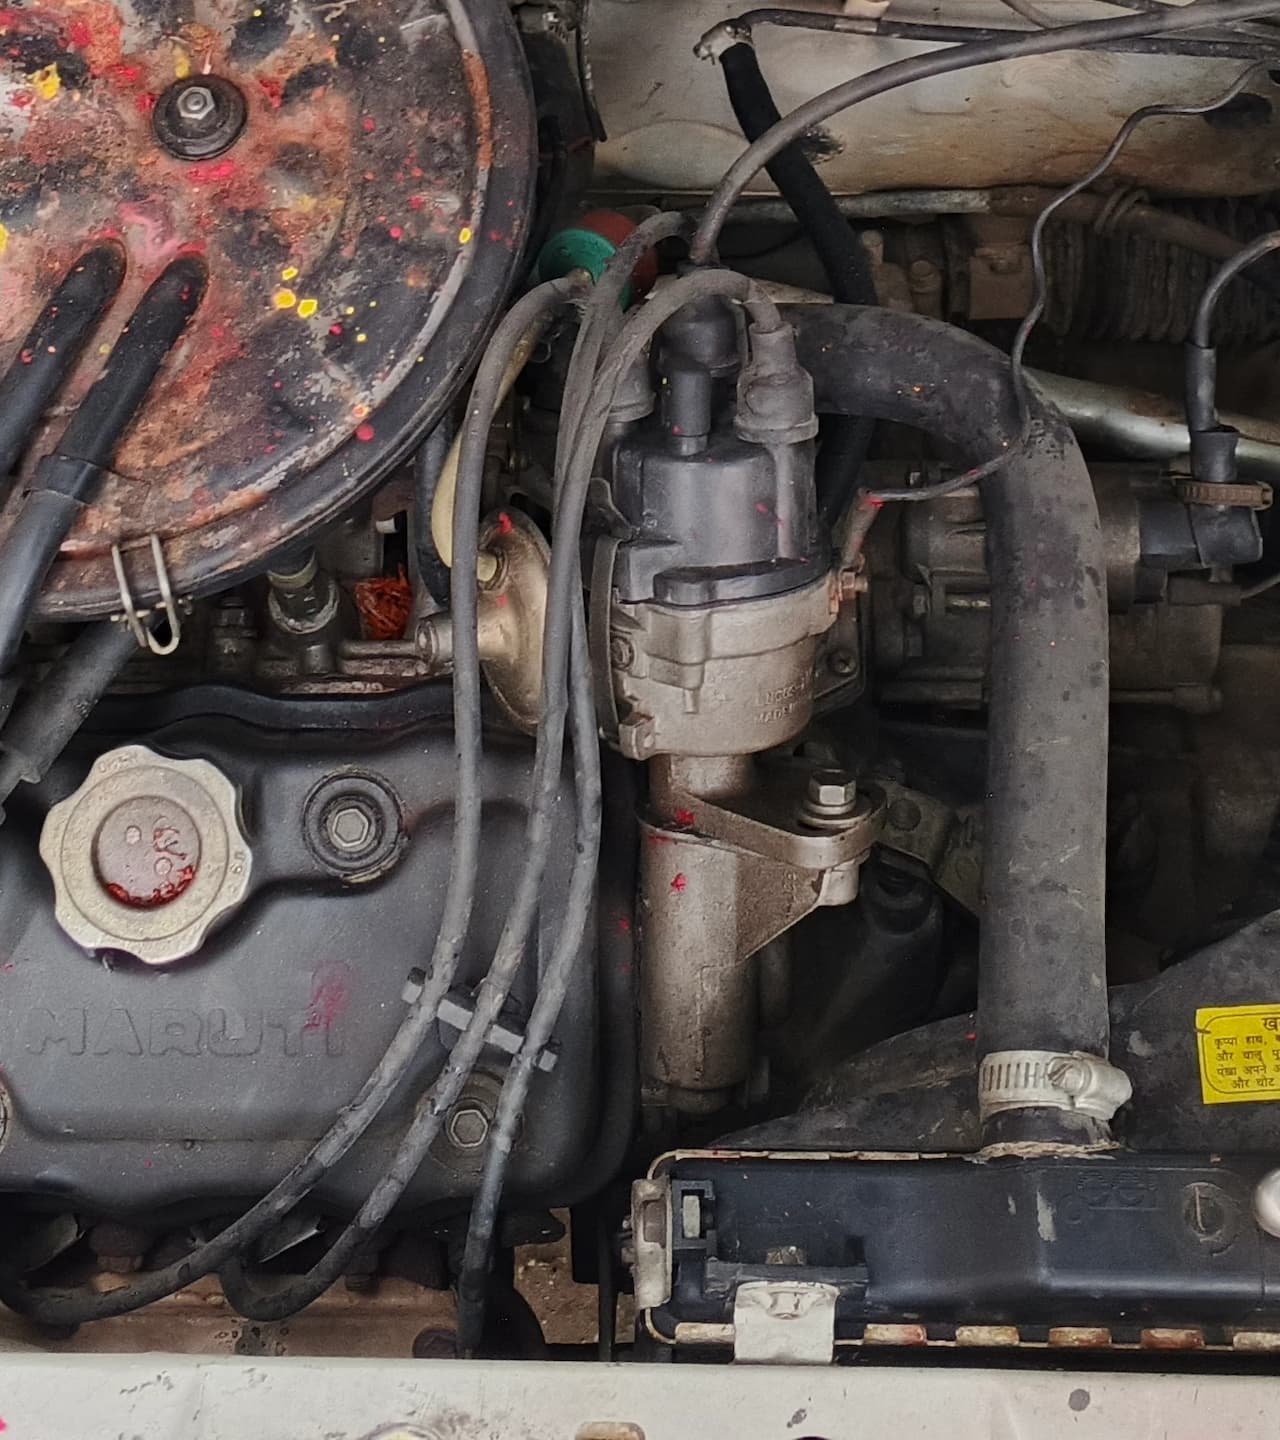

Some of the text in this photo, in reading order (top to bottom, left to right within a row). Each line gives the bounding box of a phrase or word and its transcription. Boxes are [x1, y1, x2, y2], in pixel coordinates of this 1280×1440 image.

[24, 1006, 347, 1059] MARUTI
[1216, 1050, 1234, 1062] और
[1217, 1064, 1236, 1076] पंखा
[1232, 1077, 1249, 1089] और
